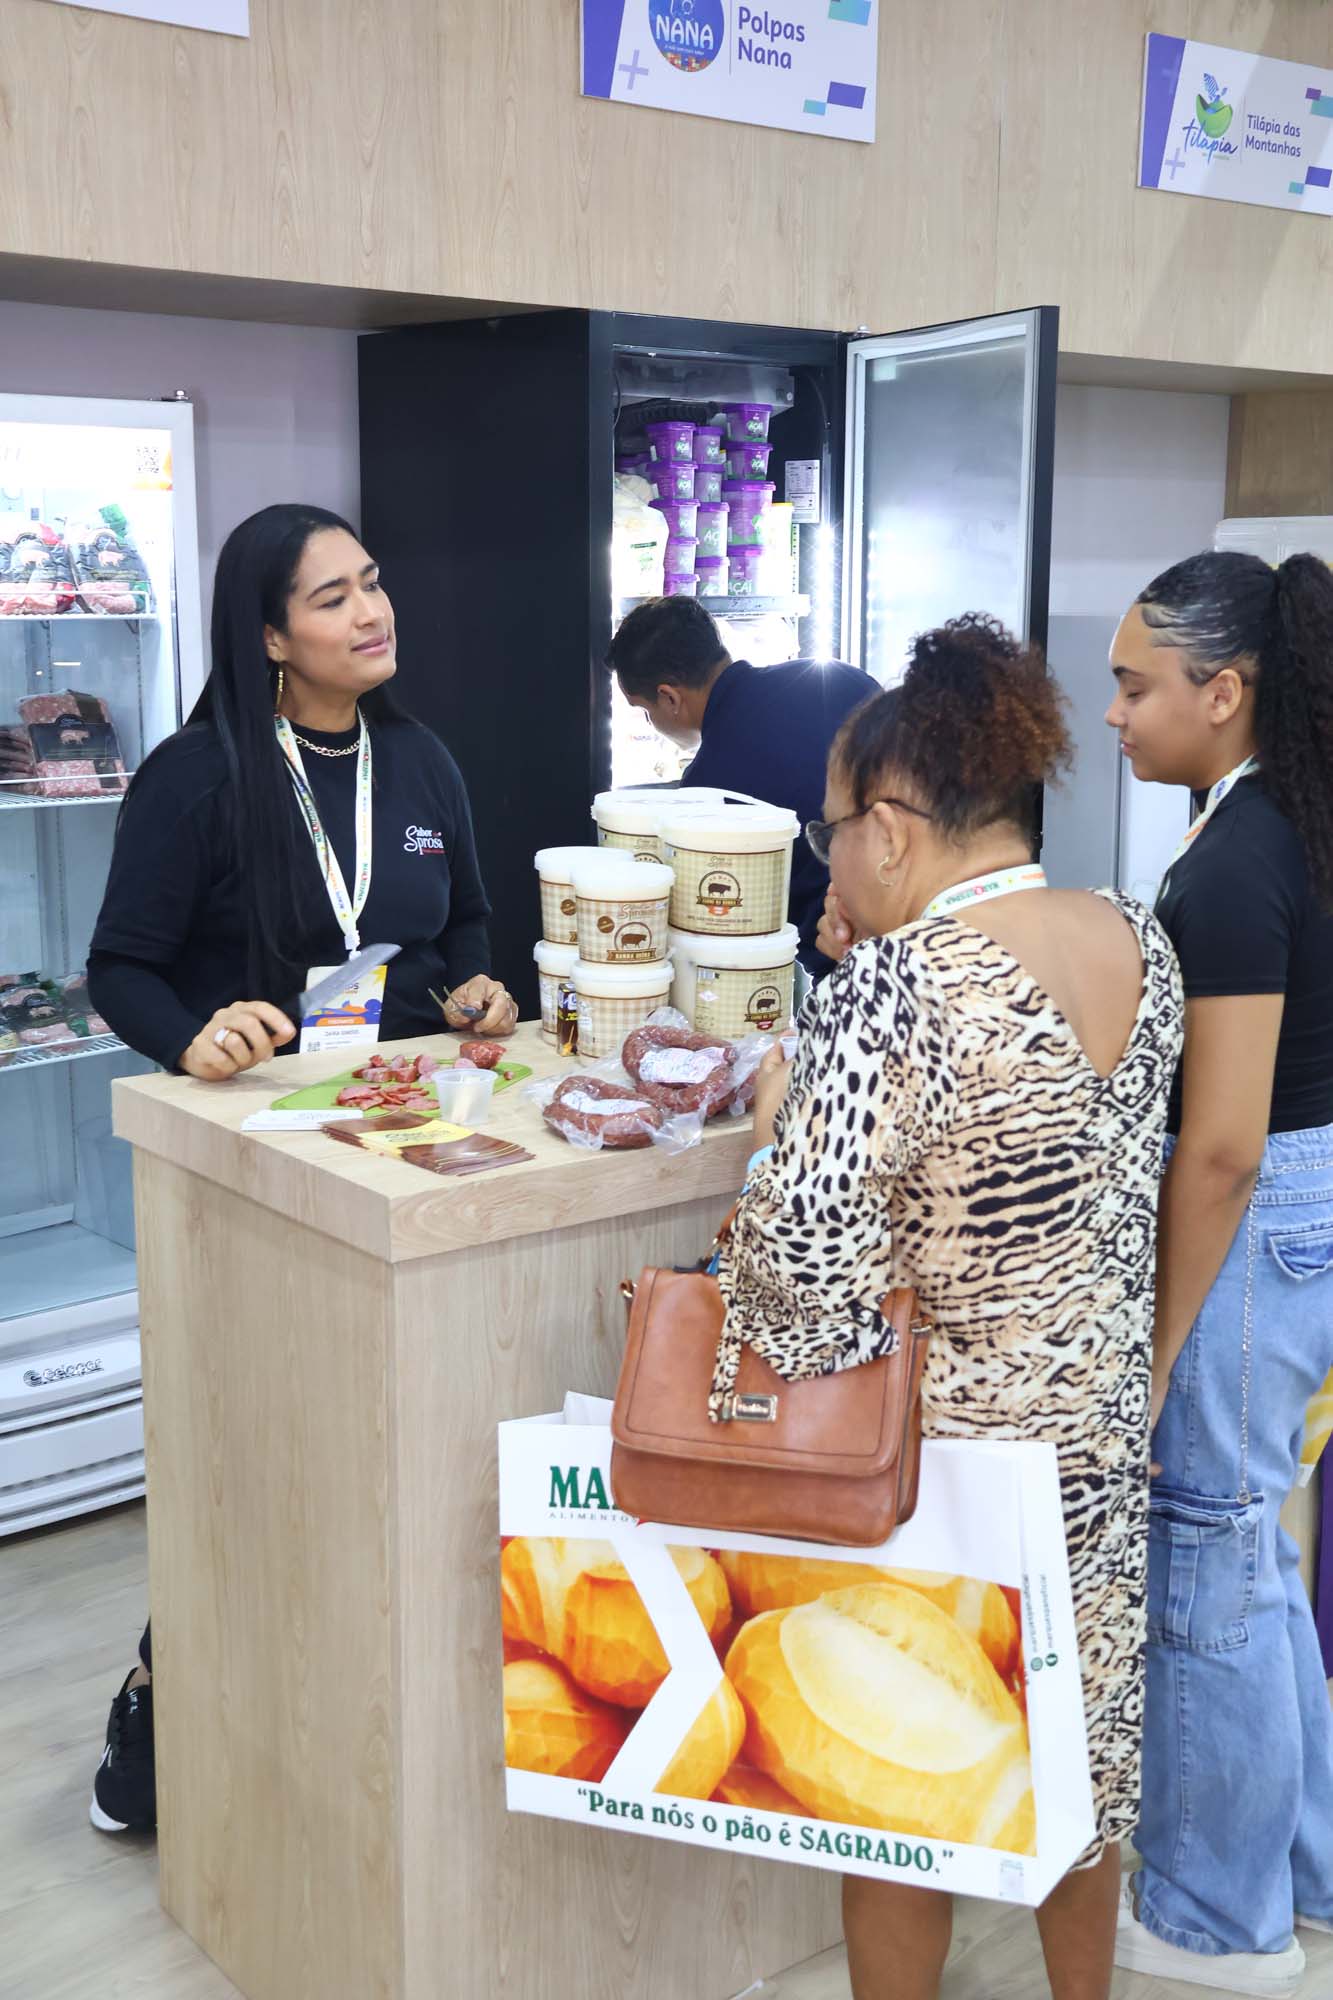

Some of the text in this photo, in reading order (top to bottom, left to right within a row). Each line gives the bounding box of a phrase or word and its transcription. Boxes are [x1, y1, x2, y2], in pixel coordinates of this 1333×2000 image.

[655, 14, 714, 50] NANA
[738, 7, 806, 42] Polpas
[737, 37, 792, 70] Nana
[1247, 114, 1301, 138] Tilápia das
[1245, 135, 1302, 158] Montanhas
[651, 1801, 695, 1830] nós
[702, 1812, 718, 1833] o
[725, 1815, 772, 1842] pão
[779, 1820, 793, 1847] é
